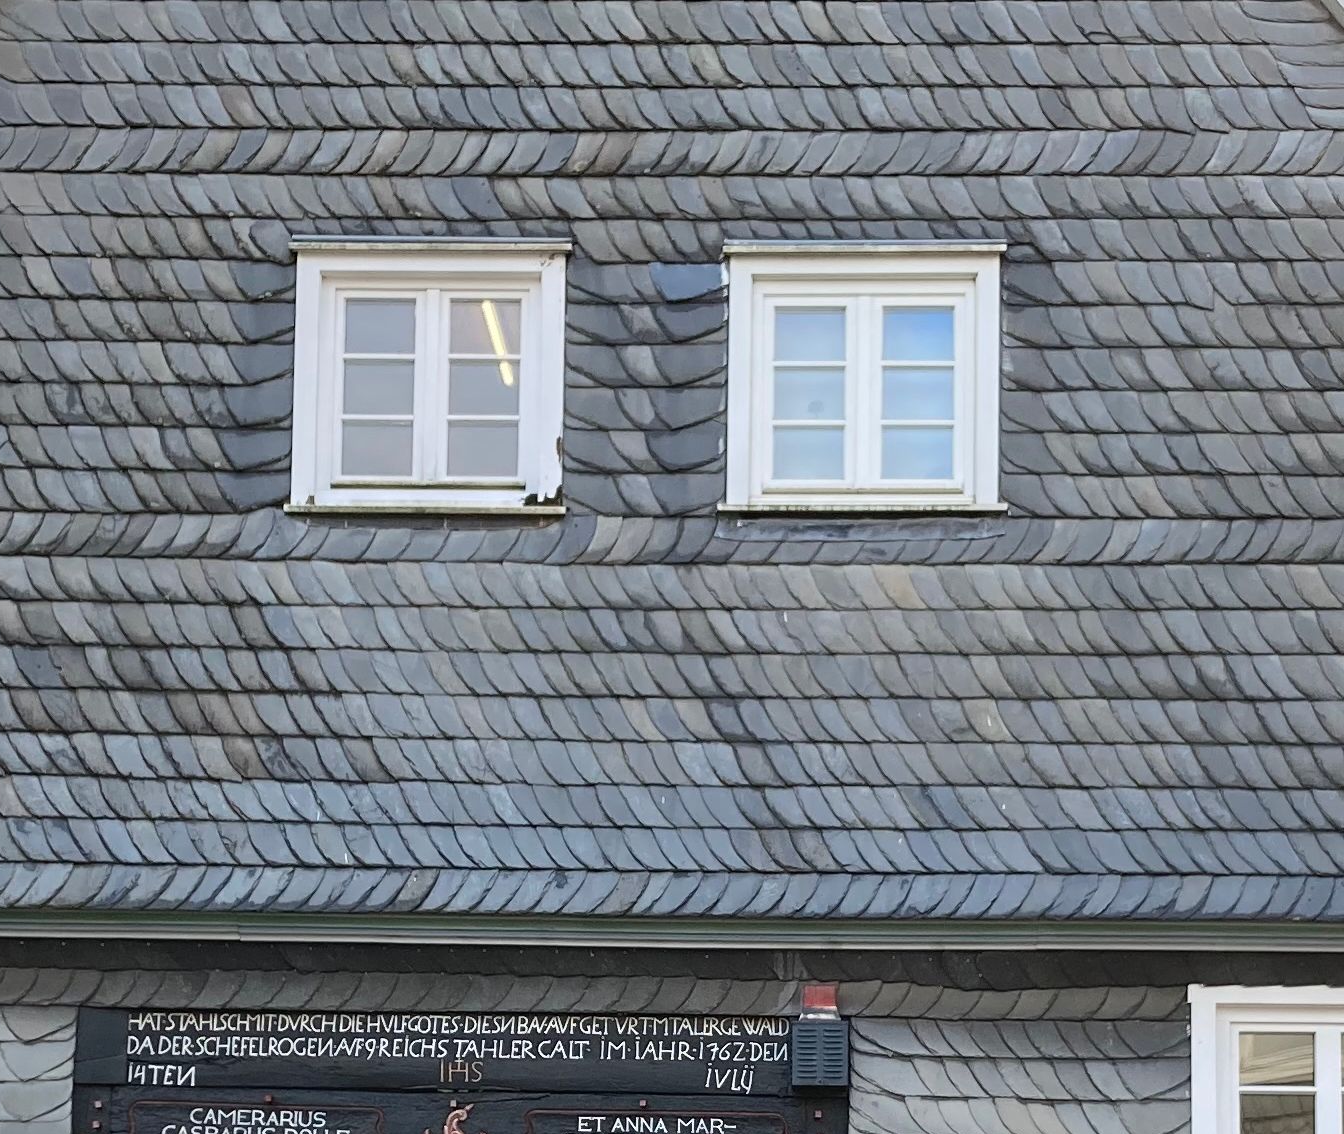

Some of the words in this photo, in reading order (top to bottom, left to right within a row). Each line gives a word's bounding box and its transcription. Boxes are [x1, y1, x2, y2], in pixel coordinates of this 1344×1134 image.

[189, 1107, 327, 1128] CAMERARIUS
[577, 1116, 606, 1132] ET
[611, 1117, 668, 1133] ANNA
[677, 1118, 737, 1134] MAR-
